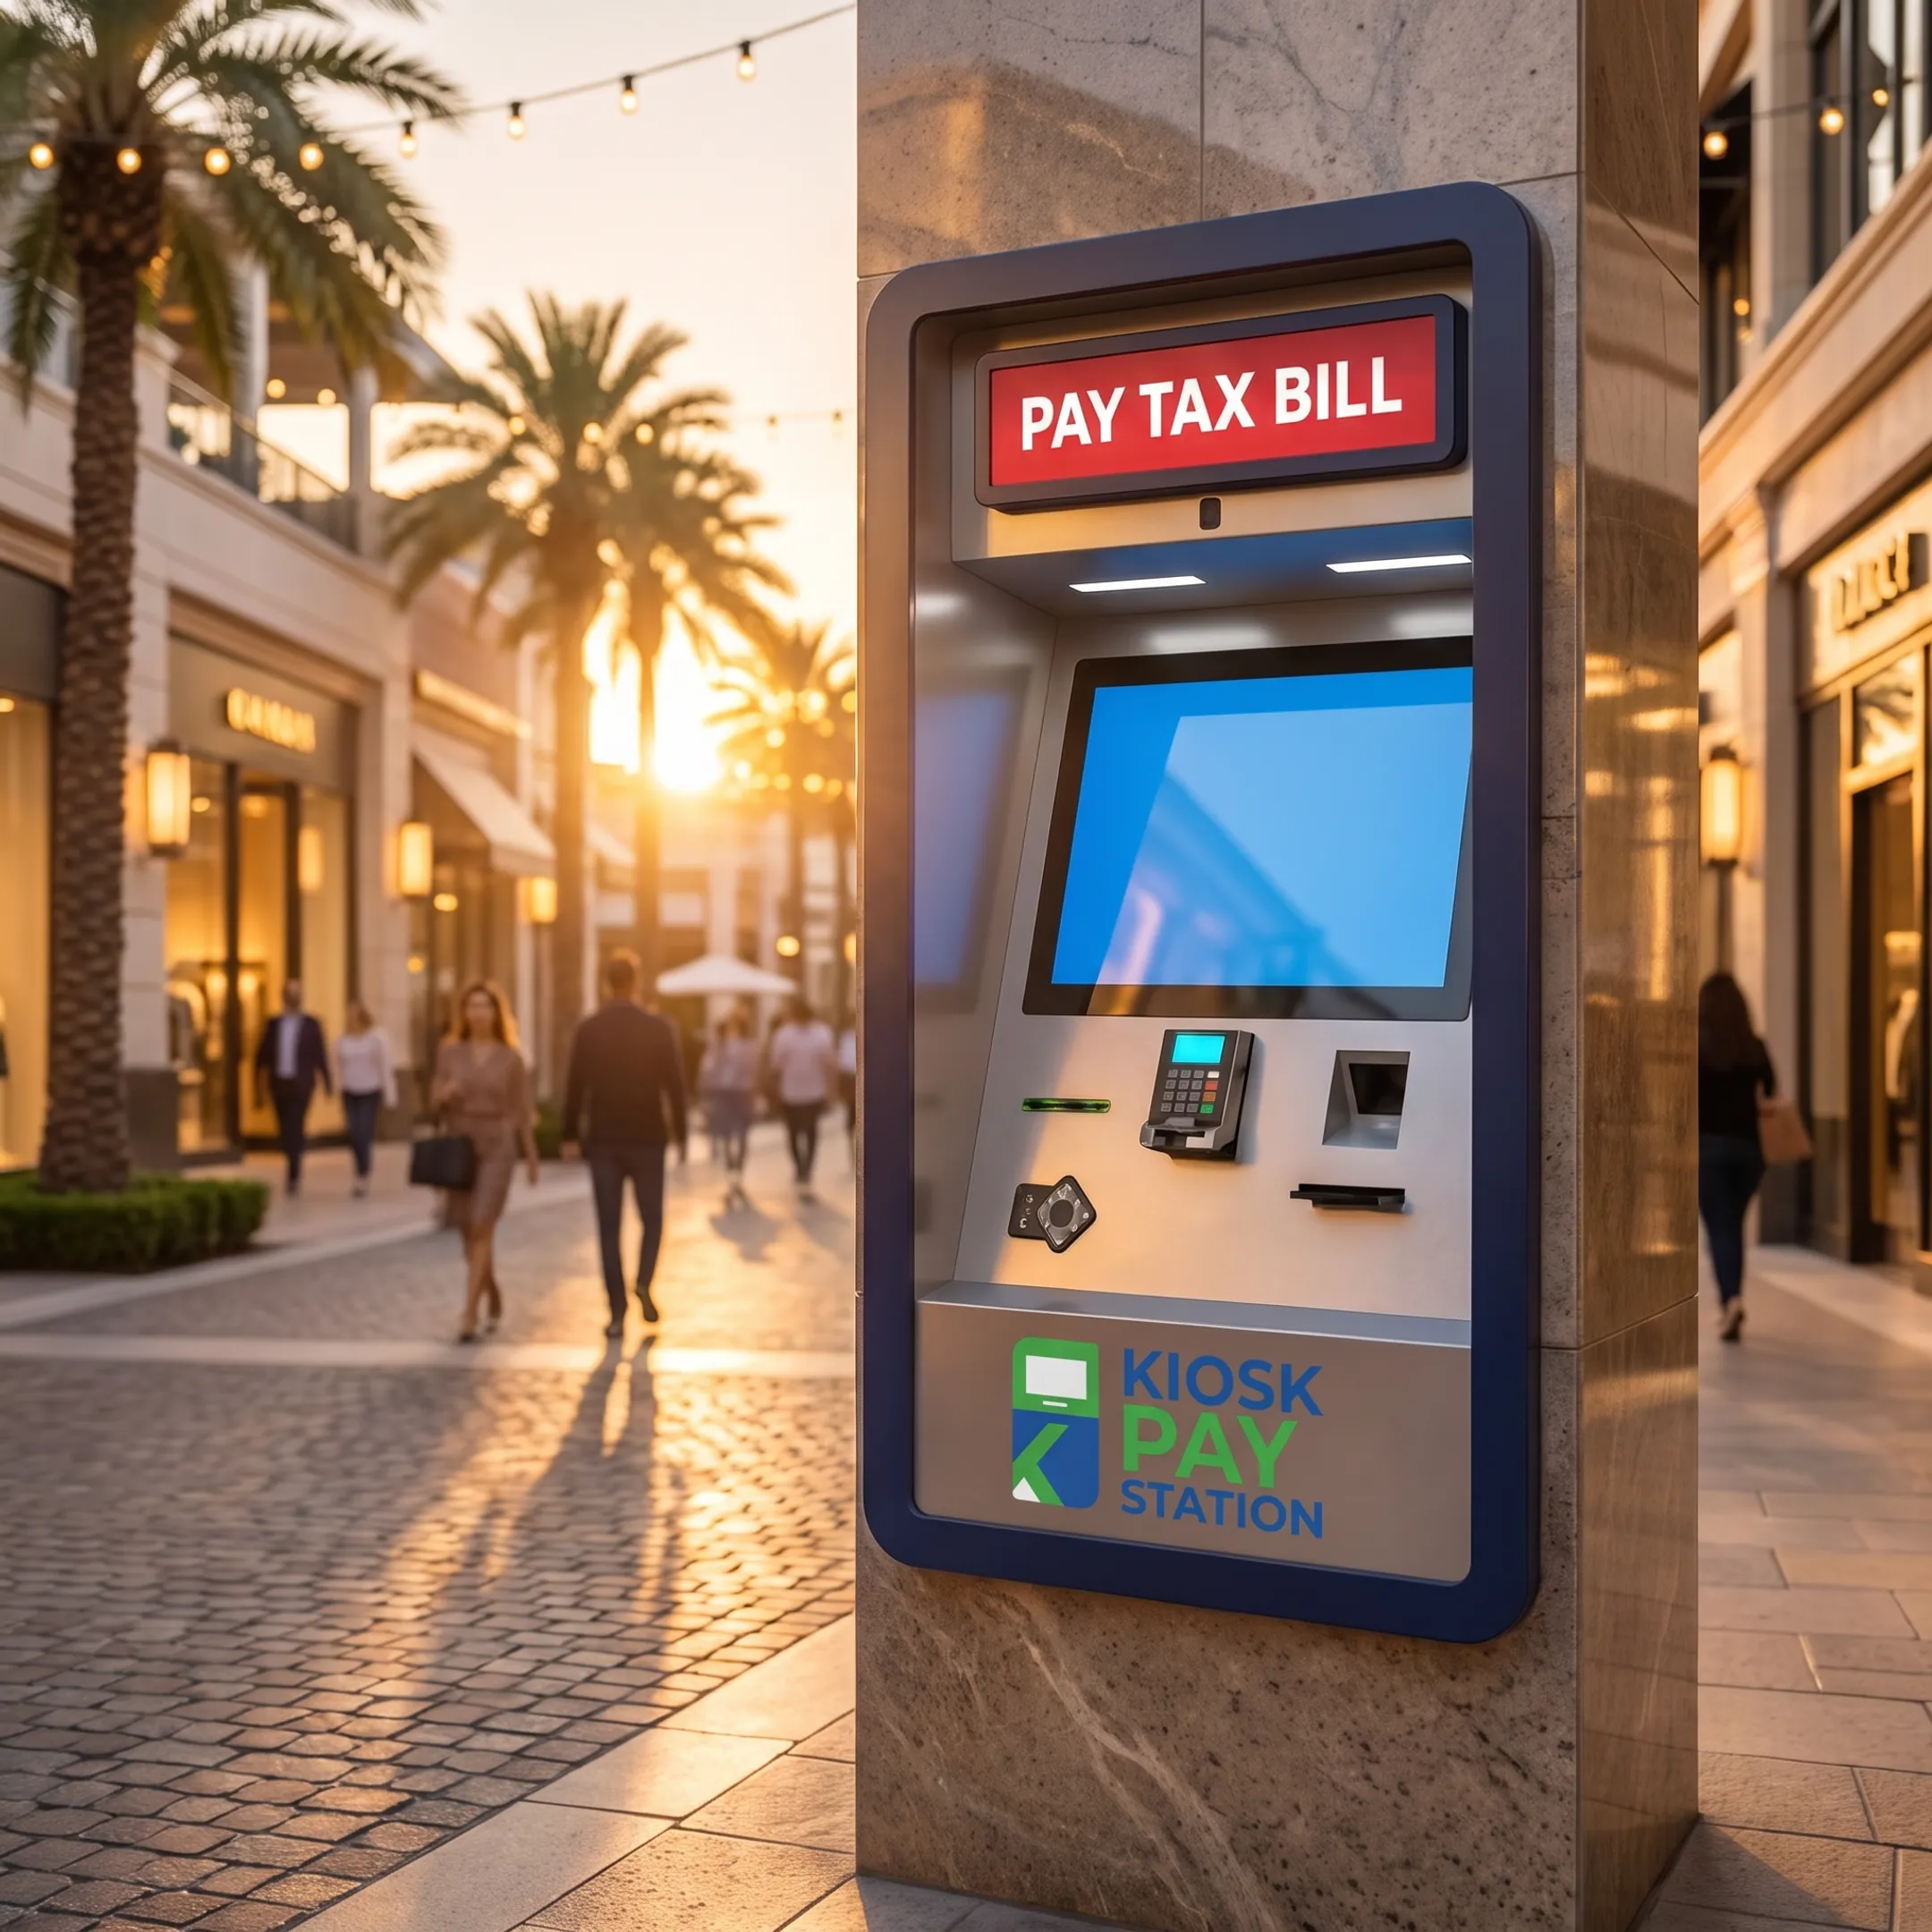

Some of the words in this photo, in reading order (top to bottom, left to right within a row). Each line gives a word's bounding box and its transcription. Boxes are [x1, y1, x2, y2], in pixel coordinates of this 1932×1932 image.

[1021, 386, 1126, 452] PAY
[1139, 370, 1256, 438] TAX
[1275, 356, 1403, 425] BILL
[1123, 1348, 1324, 1417] KIOSK
[1123, 1403, 1298, 1488] PAY
[1121, 1479, 1323, 1539] STATION
